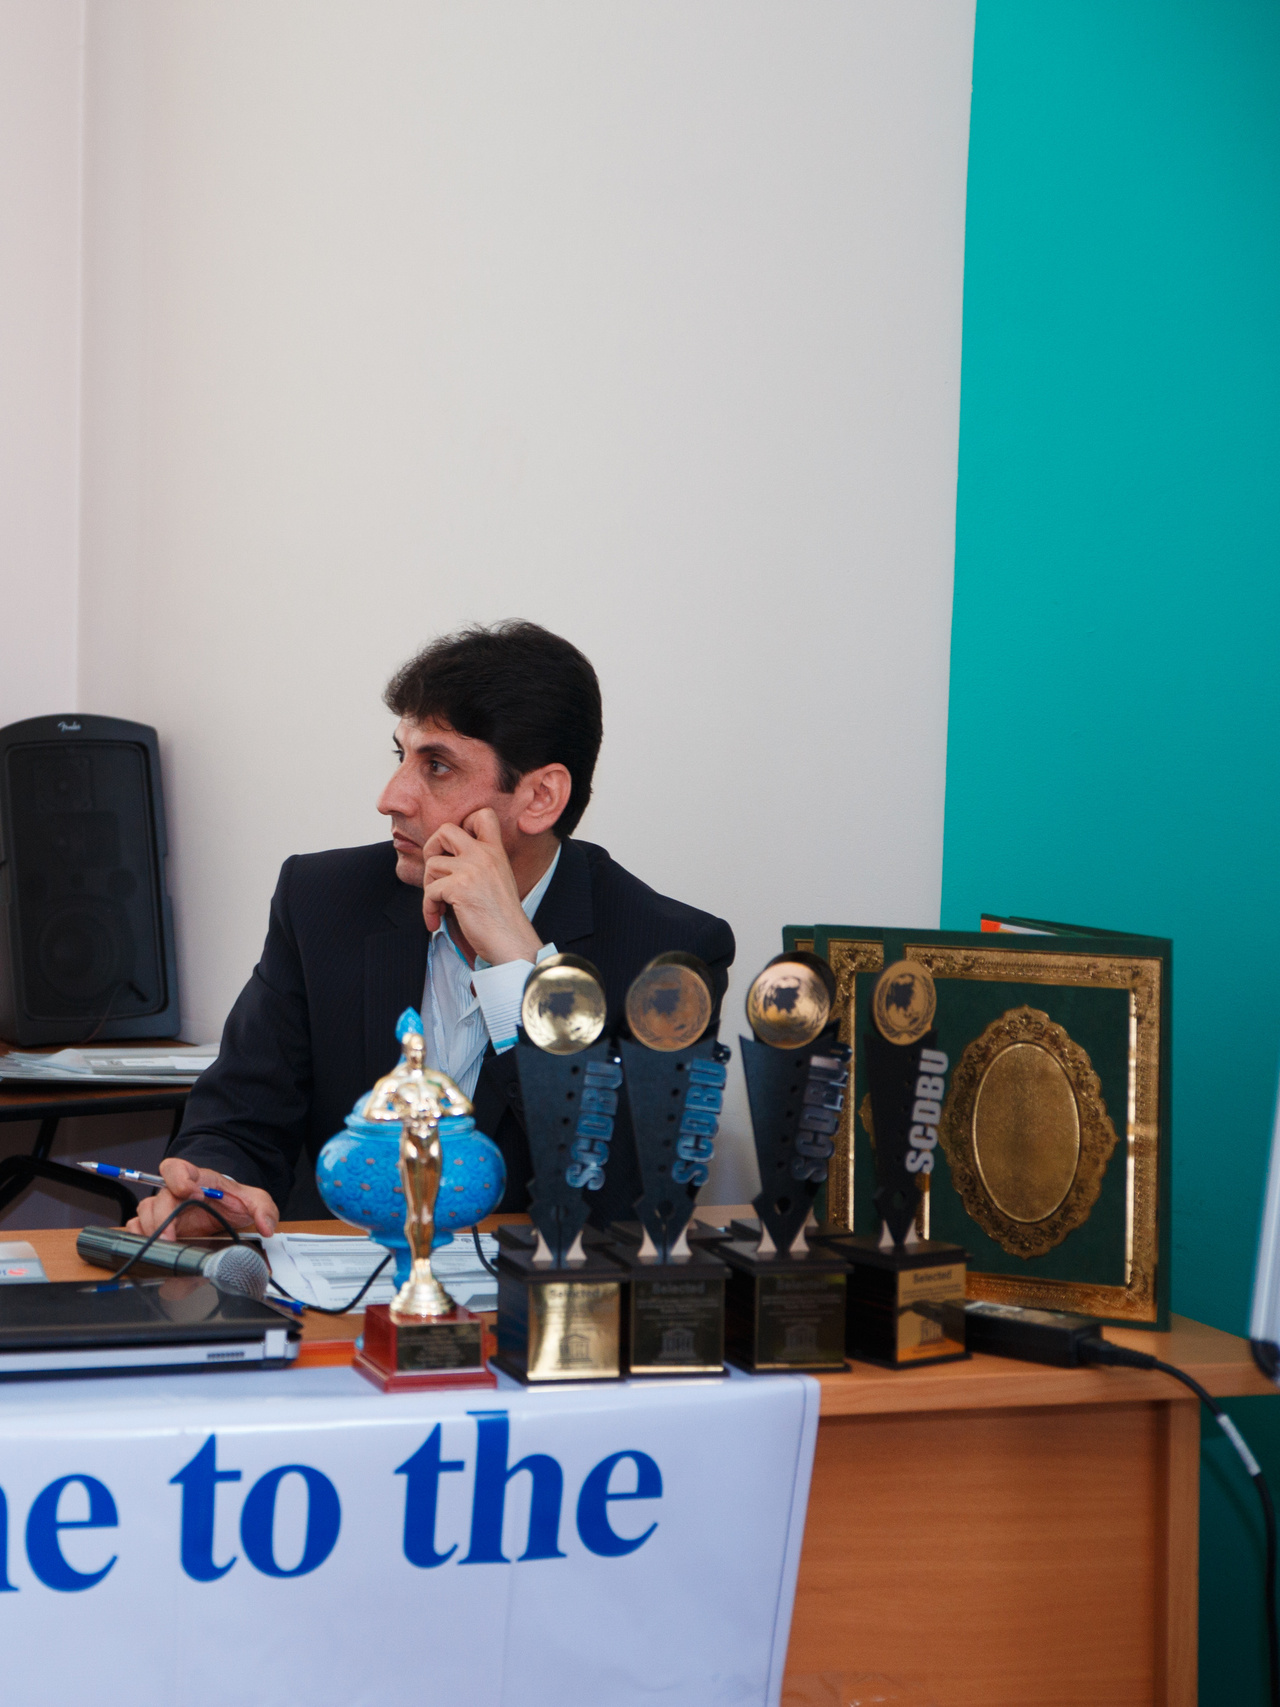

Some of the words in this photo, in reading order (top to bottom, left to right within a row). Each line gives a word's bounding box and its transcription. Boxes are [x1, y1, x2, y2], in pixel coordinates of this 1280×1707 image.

[565, 1061, 623, 1191] SCDBU
[672, 1058, 727, 1187] SCDBU
[905, 1049, 949, 1174] SCDBU
[913, 1269, 952, 1284] Selected
[169, 1434, 342, 1583] to
[394, 1409, 663, 1569] the
